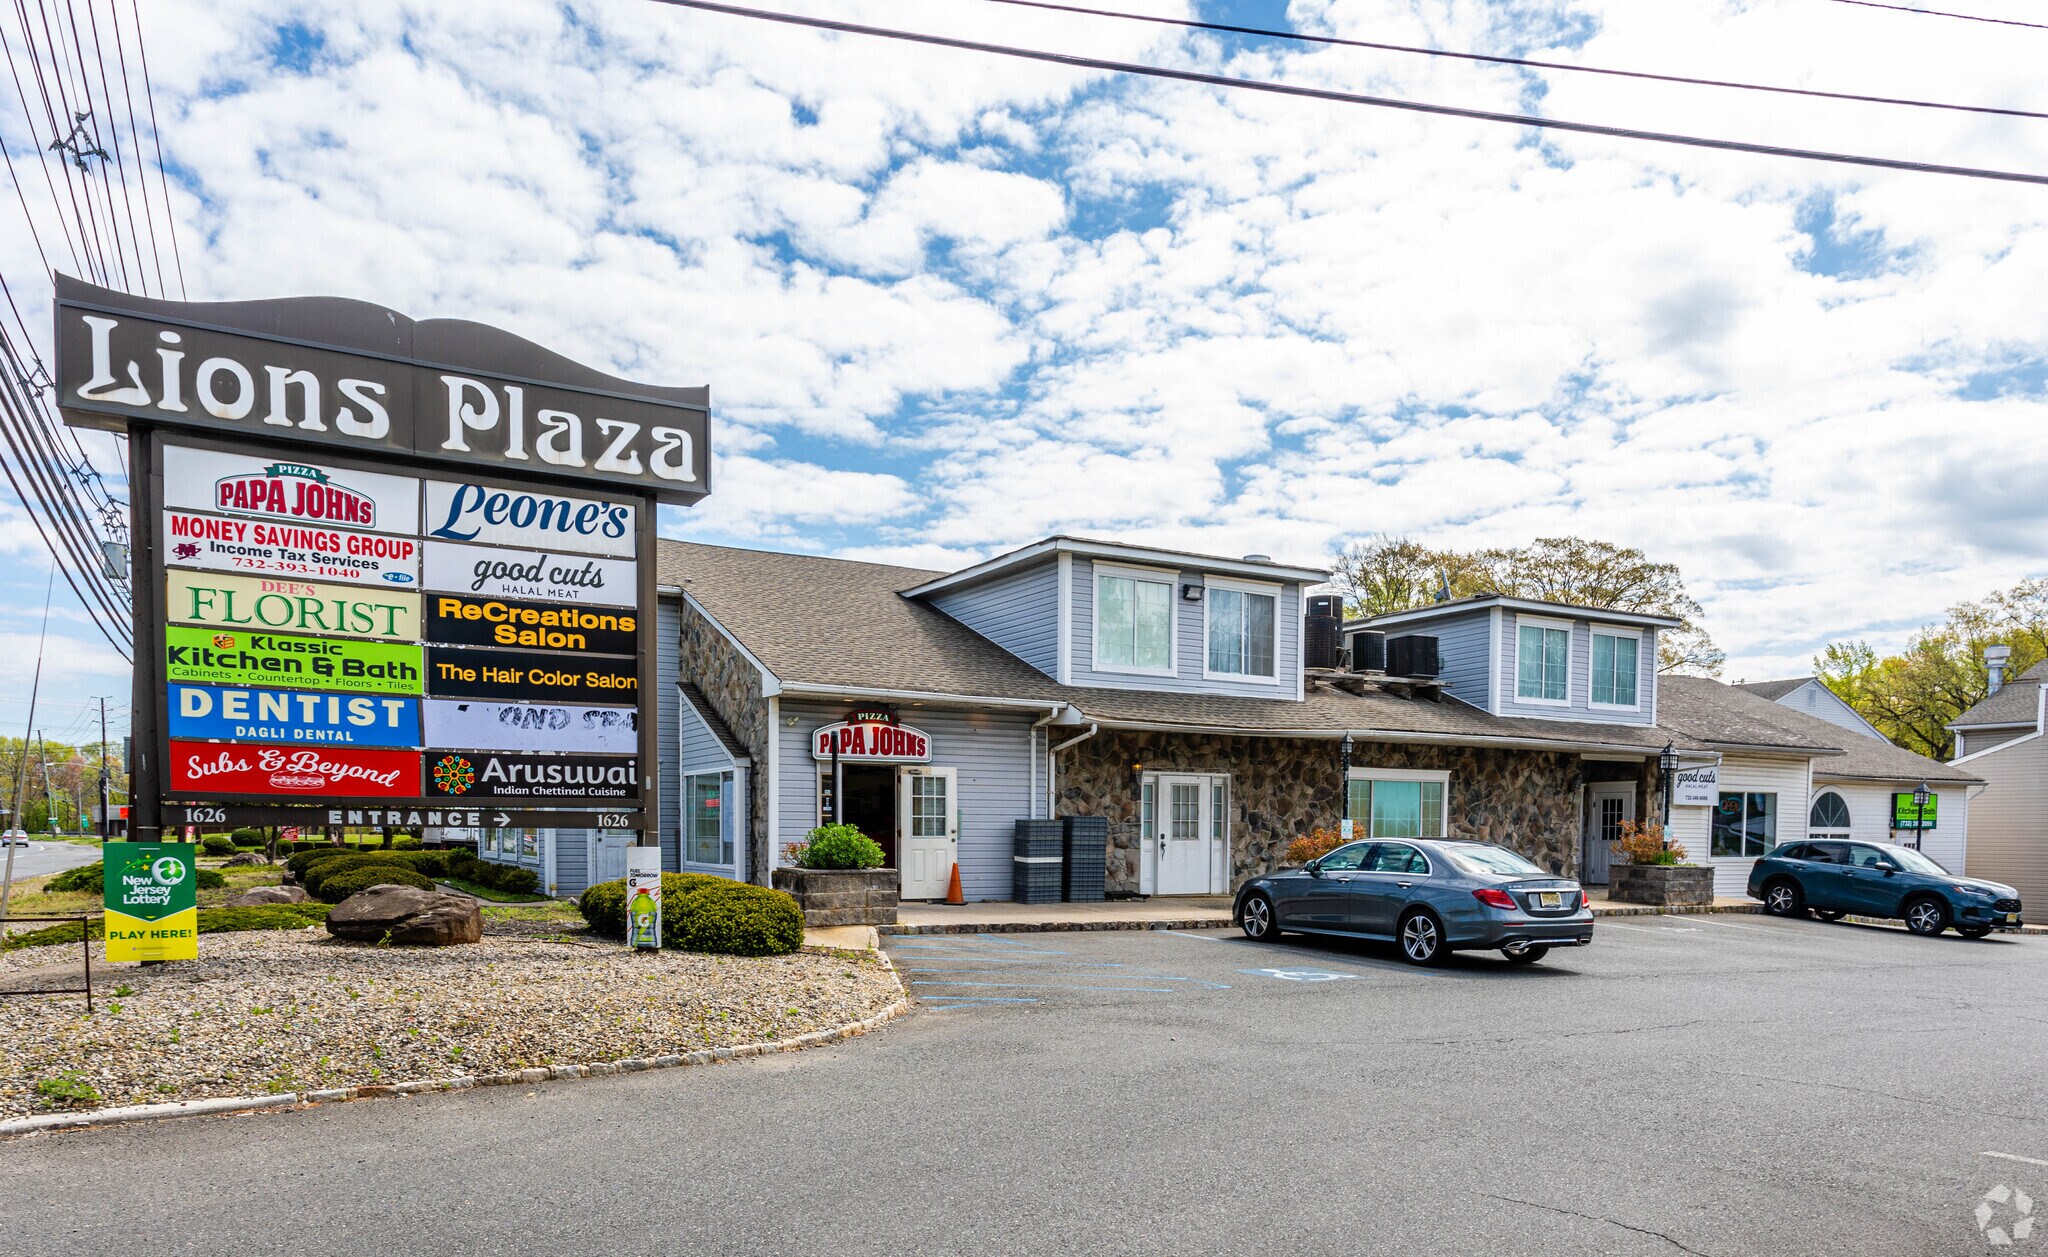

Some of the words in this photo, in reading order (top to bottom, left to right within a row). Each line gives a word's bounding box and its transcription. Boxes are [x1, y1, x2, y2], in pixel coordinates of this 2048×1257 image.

[76, 315, 390, 439] Lions
[440, 375, 697, 482] Plaza
[278, 464, 318, 478] PIZZA
[220, 479, 287, 513] PAPA
[291, 481, 372, 525] JOHNS
[430, 483, 629, 541] Leone's
[171, 515, 247, 542] MONEY
[253, 524, 340, 553] SAVINGS
[346, 535, 414, 561] GROUP
[210, 541, 272, 558] Income
[278, 548, 306, 562] Tax
[311, 552, 380, 570] Services
[232, 557, 360, 579] 732-393-1040
[471, 554, 548, 592] good
[549, 561, 605, 588] cuts
[261, 580, 316, 596] DEE'S
[502, 584, 543, 596] HALAL
[548, 589, 579, 599] MEAT
[186, 586, 408, 636] FLORIST
[438, 597, 637, 632] ReCreations
[251, 635, 343, 656] Klassic
[494, 624, 586, 650] Salon
[168, 646, 302, 674] Kitchen
[312, 656, 335, 678] &
[342, 658, 418, 680] Bath
[172, 667, 232, 680] Cabinets
[248, 672, 320, 686] Countertop
[335, 678, 373, 688] Floors
[387, 680, 414, 690] Tiles
[436, 663, 476, 682] The
[482, 667, 524, 684] Hair
[528, 669, 582, 687] Color
[585, 672, 638, 689] Salon
[180, 688, 405, 728] DENTIST
[857, 712, 890, 722] PIZZA
[236, 726, 286, 739] DAGLI
[294, 728, 354, 742] DENTAL
[187, 751, 253, 779] Subs
[286, 751, 401, 787] Beyond
[481, 757, 638, 785] Arusuvai
[1676, 769, 1699, 789] good
[1699, 771, 1716, 783] cuts
[493, 786, 530, 796] Indian
[532, 786, 586, 797] Chettinad
[588, 787, 627, 798] Cuisine
[184, 807, 226, 823] 1626
[1721, 799, 1740, 813] OPEN
[328, 810, 481, 826] ENTRANCE
[597, 814, 629, 828] 1626
[122, 876, 153, 885] New
[129, 885, 171, 896] Jersey
[123, 895, 171, 906] Lottery
[110, 930, 146, 940] PLAY
[151, 929, 192, 939] HERE!
